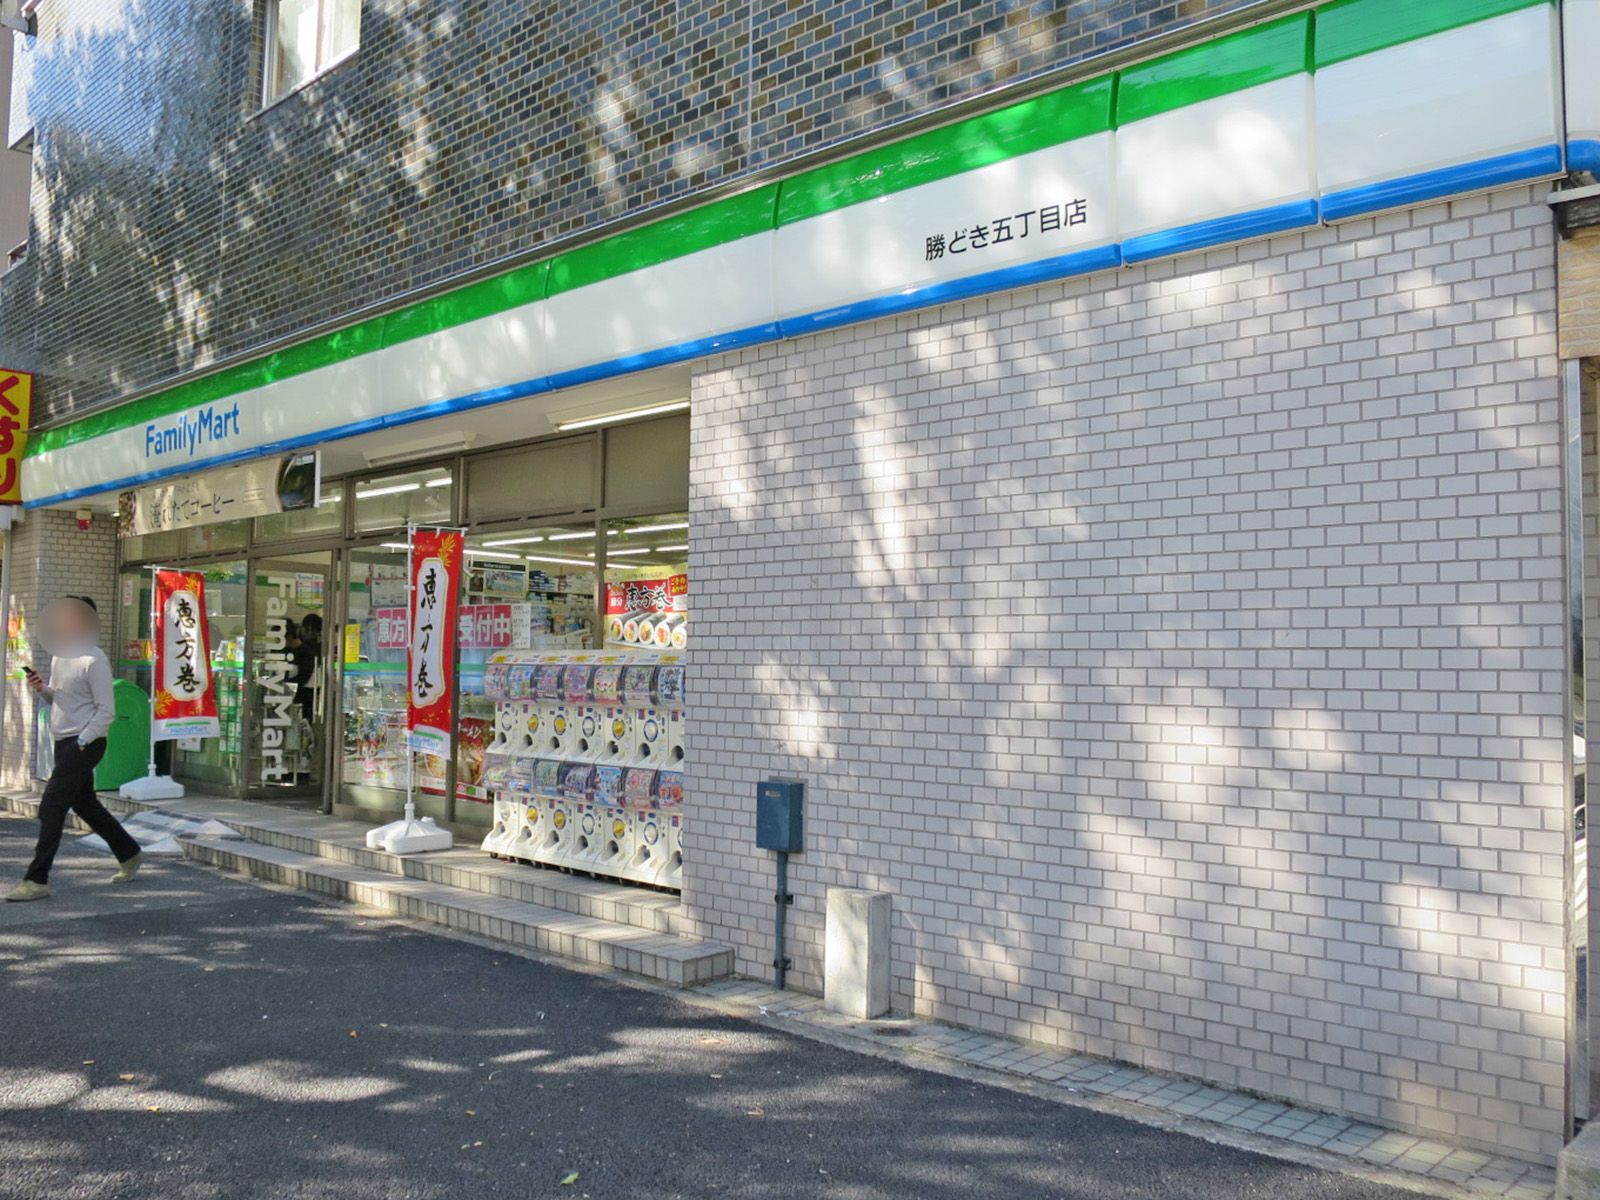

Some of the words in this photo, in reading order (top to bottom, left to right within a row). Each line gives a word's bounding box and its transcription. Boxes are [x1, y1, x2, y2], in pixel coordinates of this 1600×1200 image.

[925, 198, 1087, 261] 勝どき五丁目店
[146, 401, 240, 457] FamilyMart
[624, 582, 673, 611] 恵方巻
[174, 598, 200, 693] 恵方巻
[256, 575, 296, 781] FamilyMart
